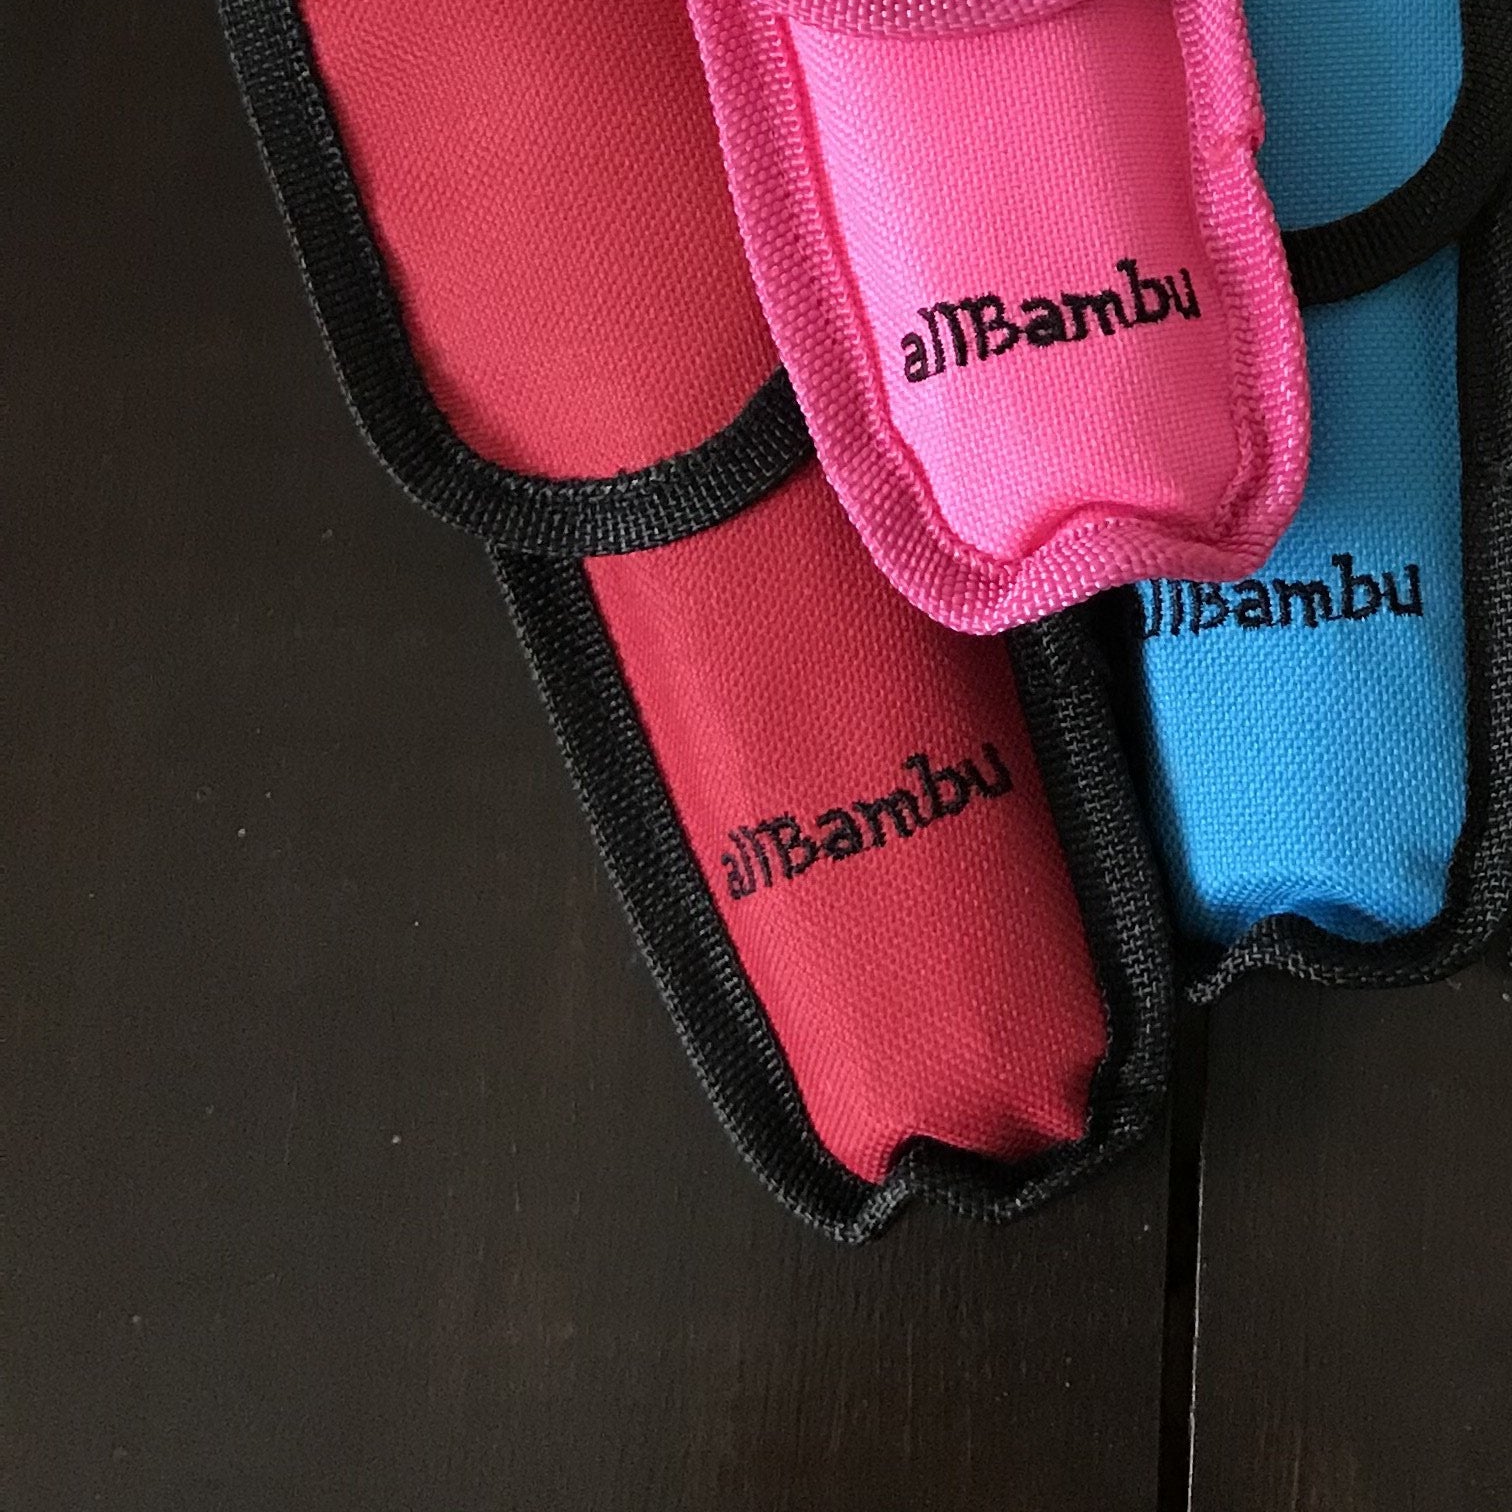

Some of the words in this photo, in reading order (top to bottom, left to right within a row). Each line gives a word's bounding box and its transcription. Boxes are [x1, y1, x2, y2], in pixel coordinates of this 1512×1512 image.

[901, 257, 1201, 383] allBambu
[1144, 551, 1424, 639] llBambu
[721, 742, 1014, 900] allBambu
